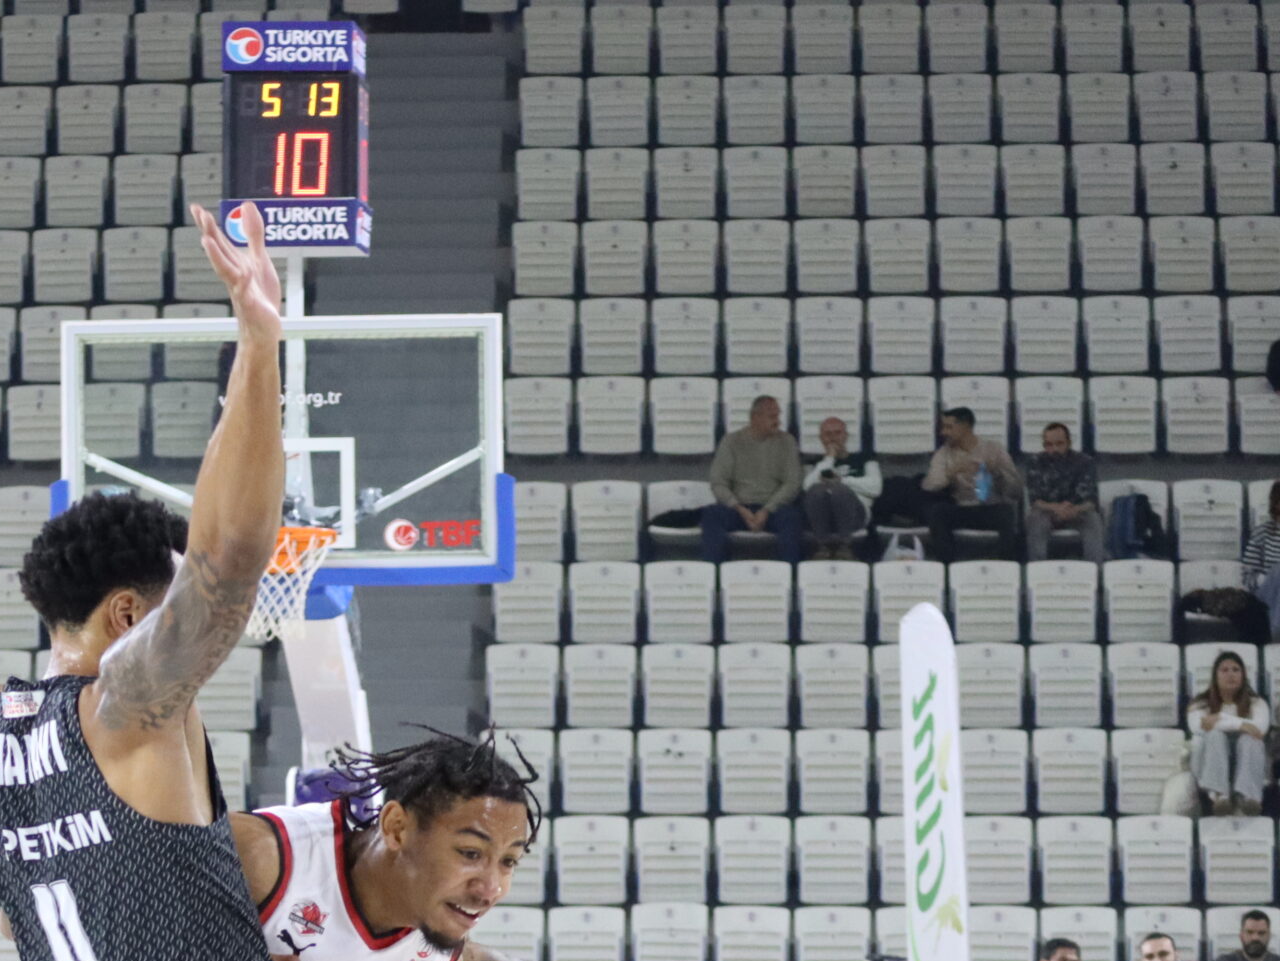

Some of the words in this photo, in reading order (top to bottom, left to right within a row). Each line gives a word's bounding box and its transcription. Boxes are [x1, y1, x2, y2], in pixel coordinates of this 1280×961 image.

[261, 82, 282, 117] 5
[307, 82, 340, 117] 13
[274, 132, 329, 196] 10
[420, 519, 481, 547] TBF
